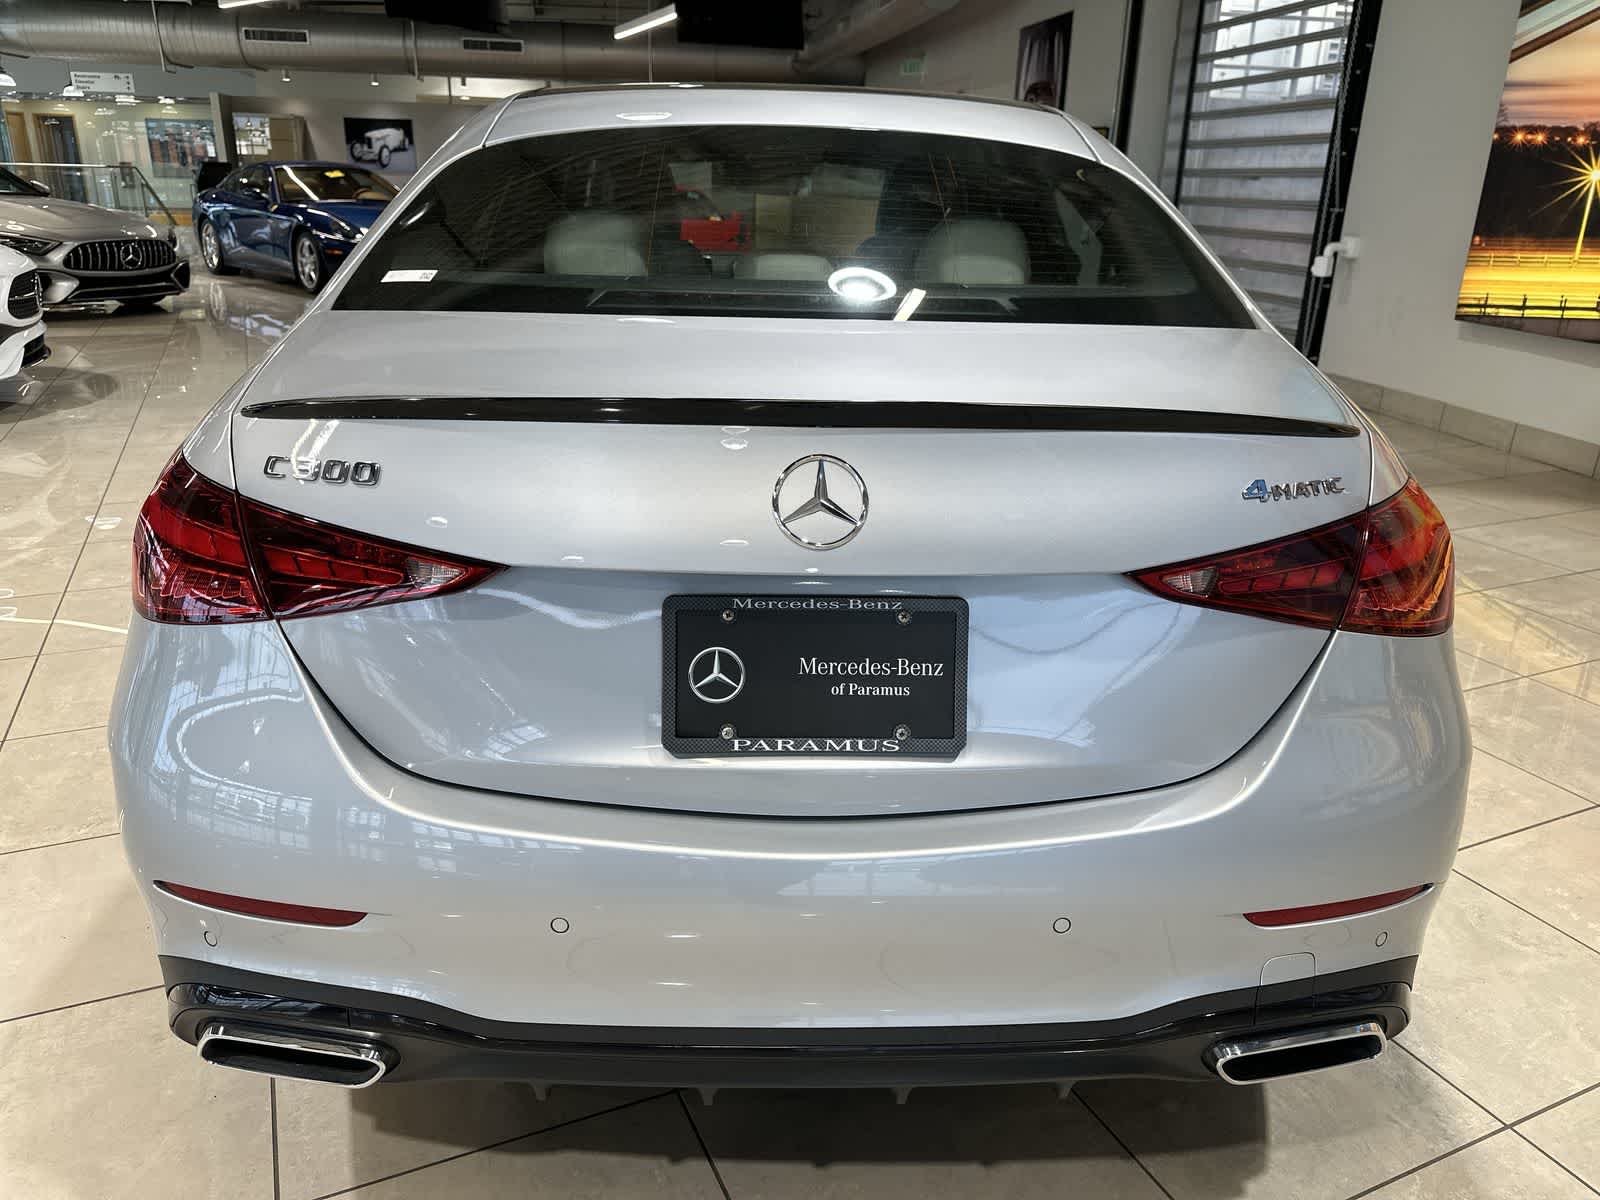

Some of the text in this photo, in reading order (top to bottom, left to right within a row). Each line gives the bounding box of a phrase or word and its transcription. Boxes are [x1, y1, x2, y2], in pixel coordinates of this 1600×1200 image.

[263, 455, 292, 479] C
[1241, 477, 1346, 503] 4MATIC
[732, 598, 903, 610] Mercedes-Benz
[799, 657, 944, 677] Mercedes-Benz
[831, 683, 911, 697] of Paramus
[731, 738, 901, 752] PARAMUS
